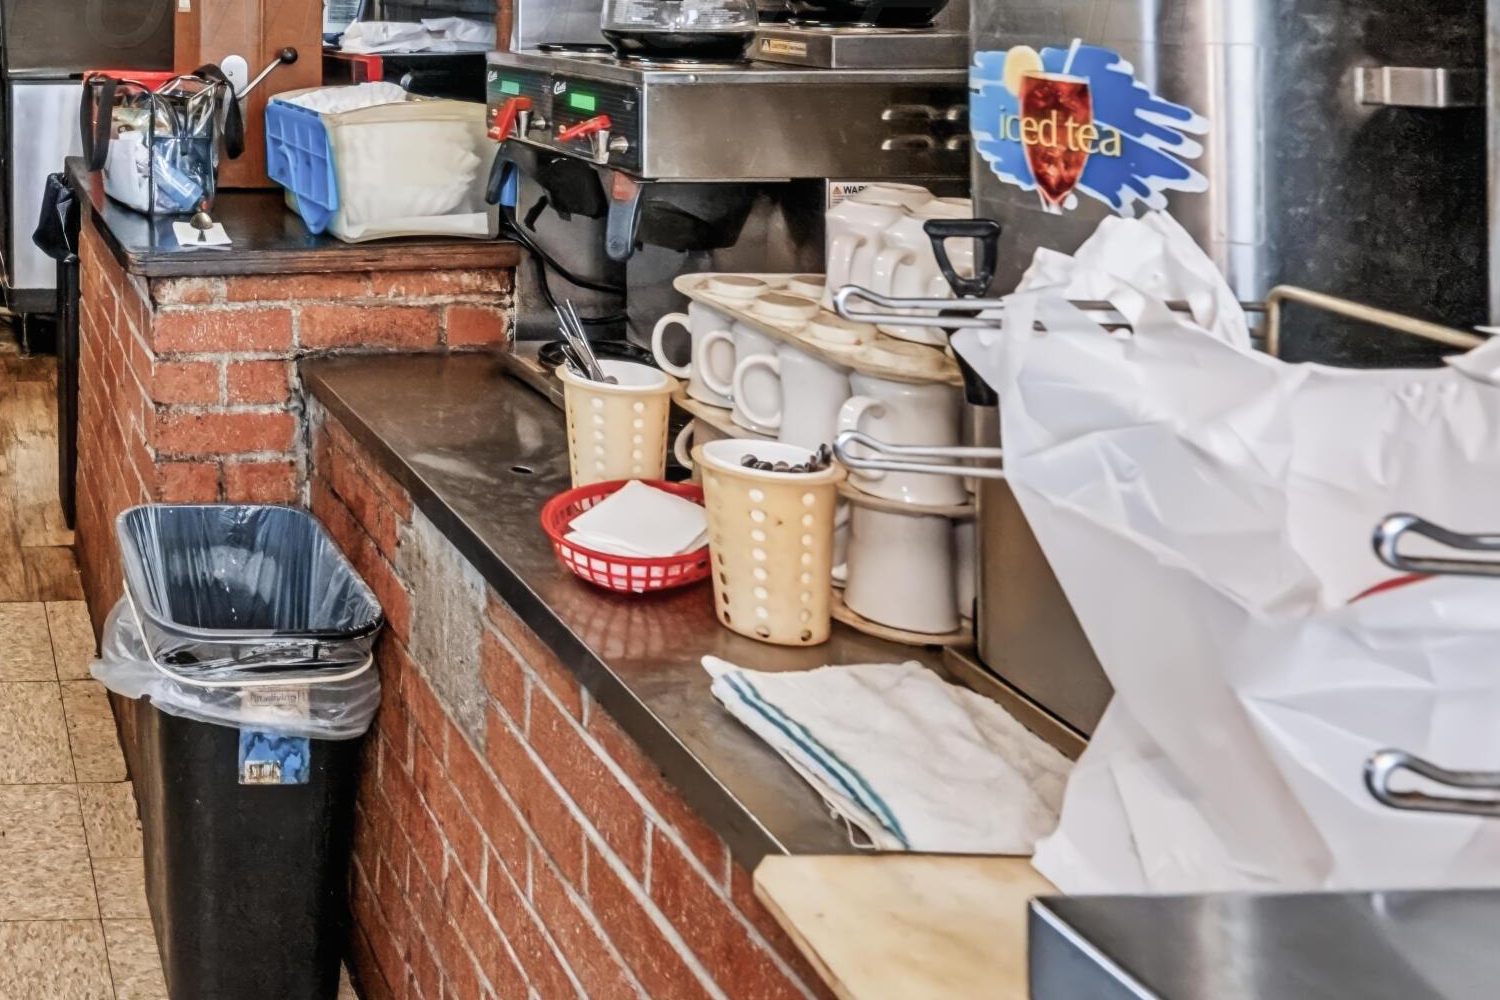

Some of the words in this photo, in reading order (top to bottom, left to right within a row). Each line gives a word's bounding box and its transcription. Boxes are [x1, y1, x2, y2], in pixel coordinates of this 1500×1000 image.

[998, 104, 1058, 148] iced
[1064, 115, 1122, 158] tea
[843, 185, 869, 195] WAR
